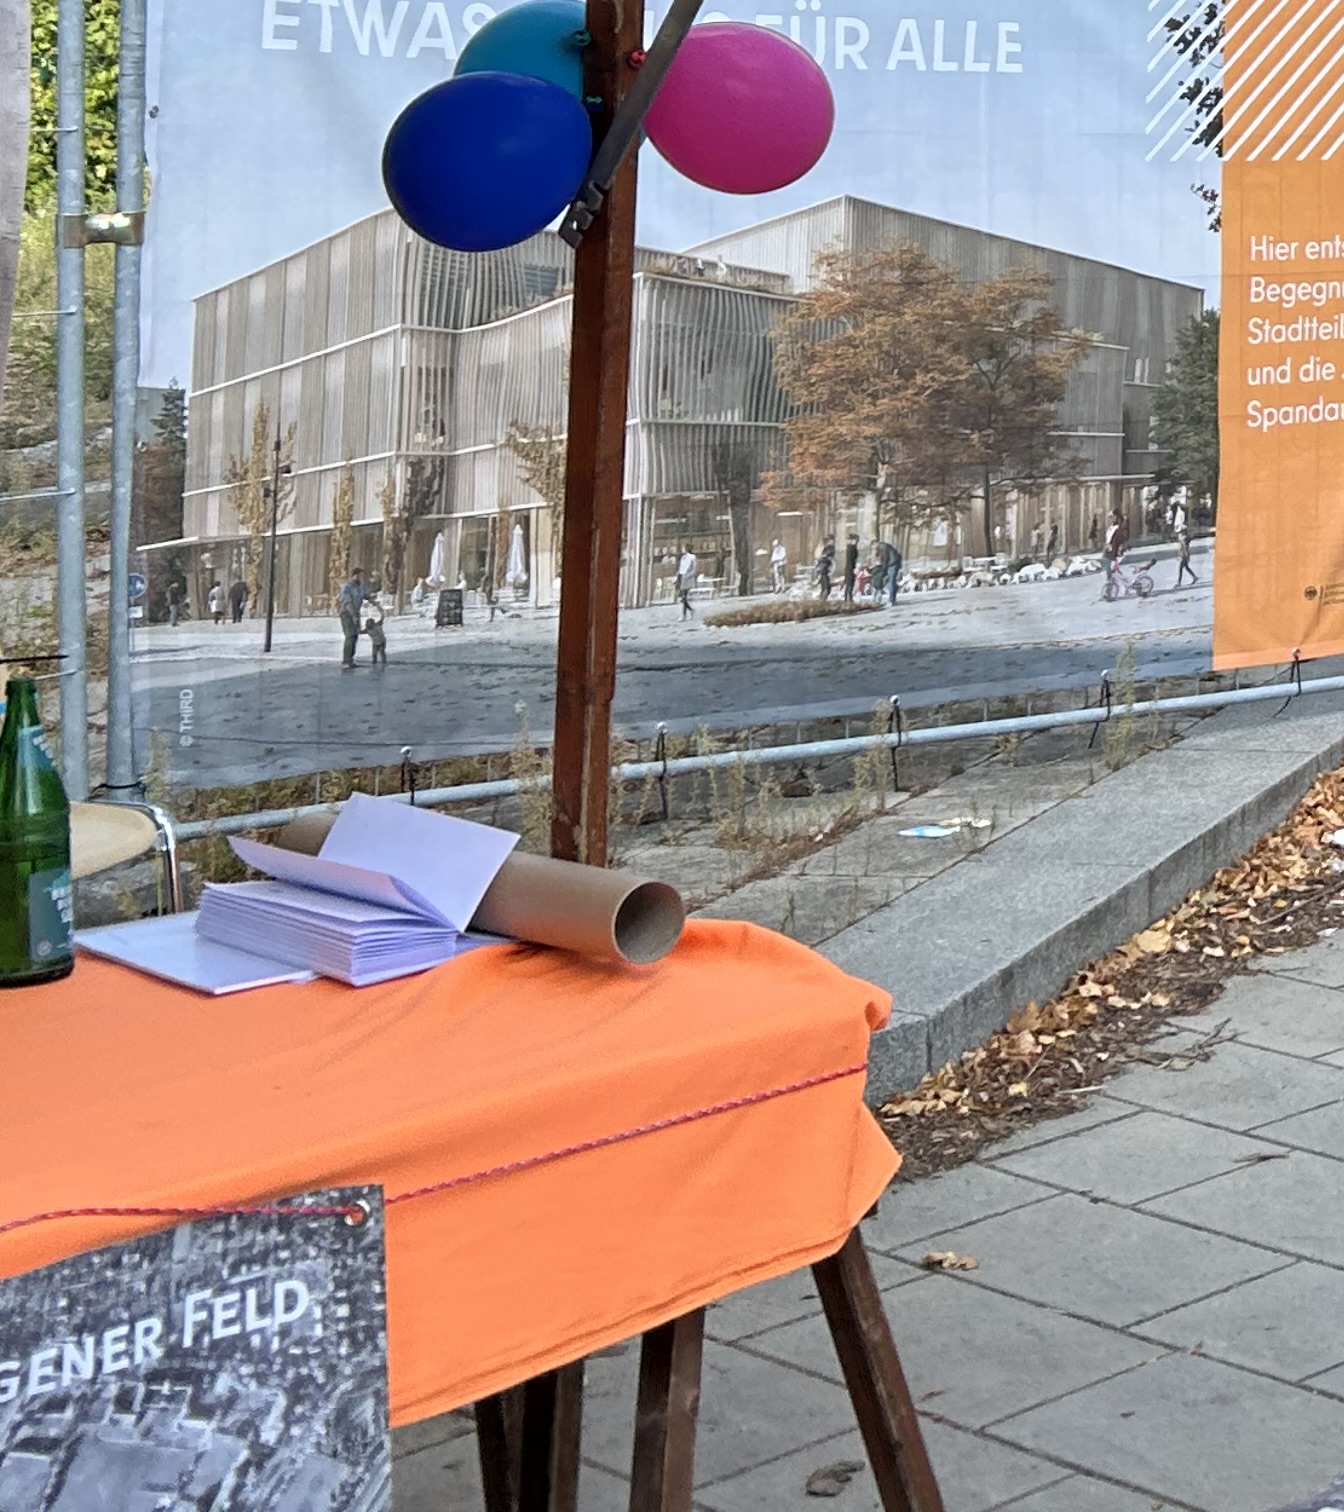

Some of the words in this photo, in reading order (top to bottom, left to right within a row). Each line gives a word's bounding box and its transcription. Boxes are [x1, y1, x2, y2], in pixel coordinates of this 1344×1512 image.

[885, 18, 1024, 73] ALLE
[1250, 235, 1299, 261] Hier
[1248, 357, 1292, 386] und
[1299, 355, 1336, 383] die
[179, 688, 194, 733] THIRD
[182, 1280, 310, 1349] FELD
